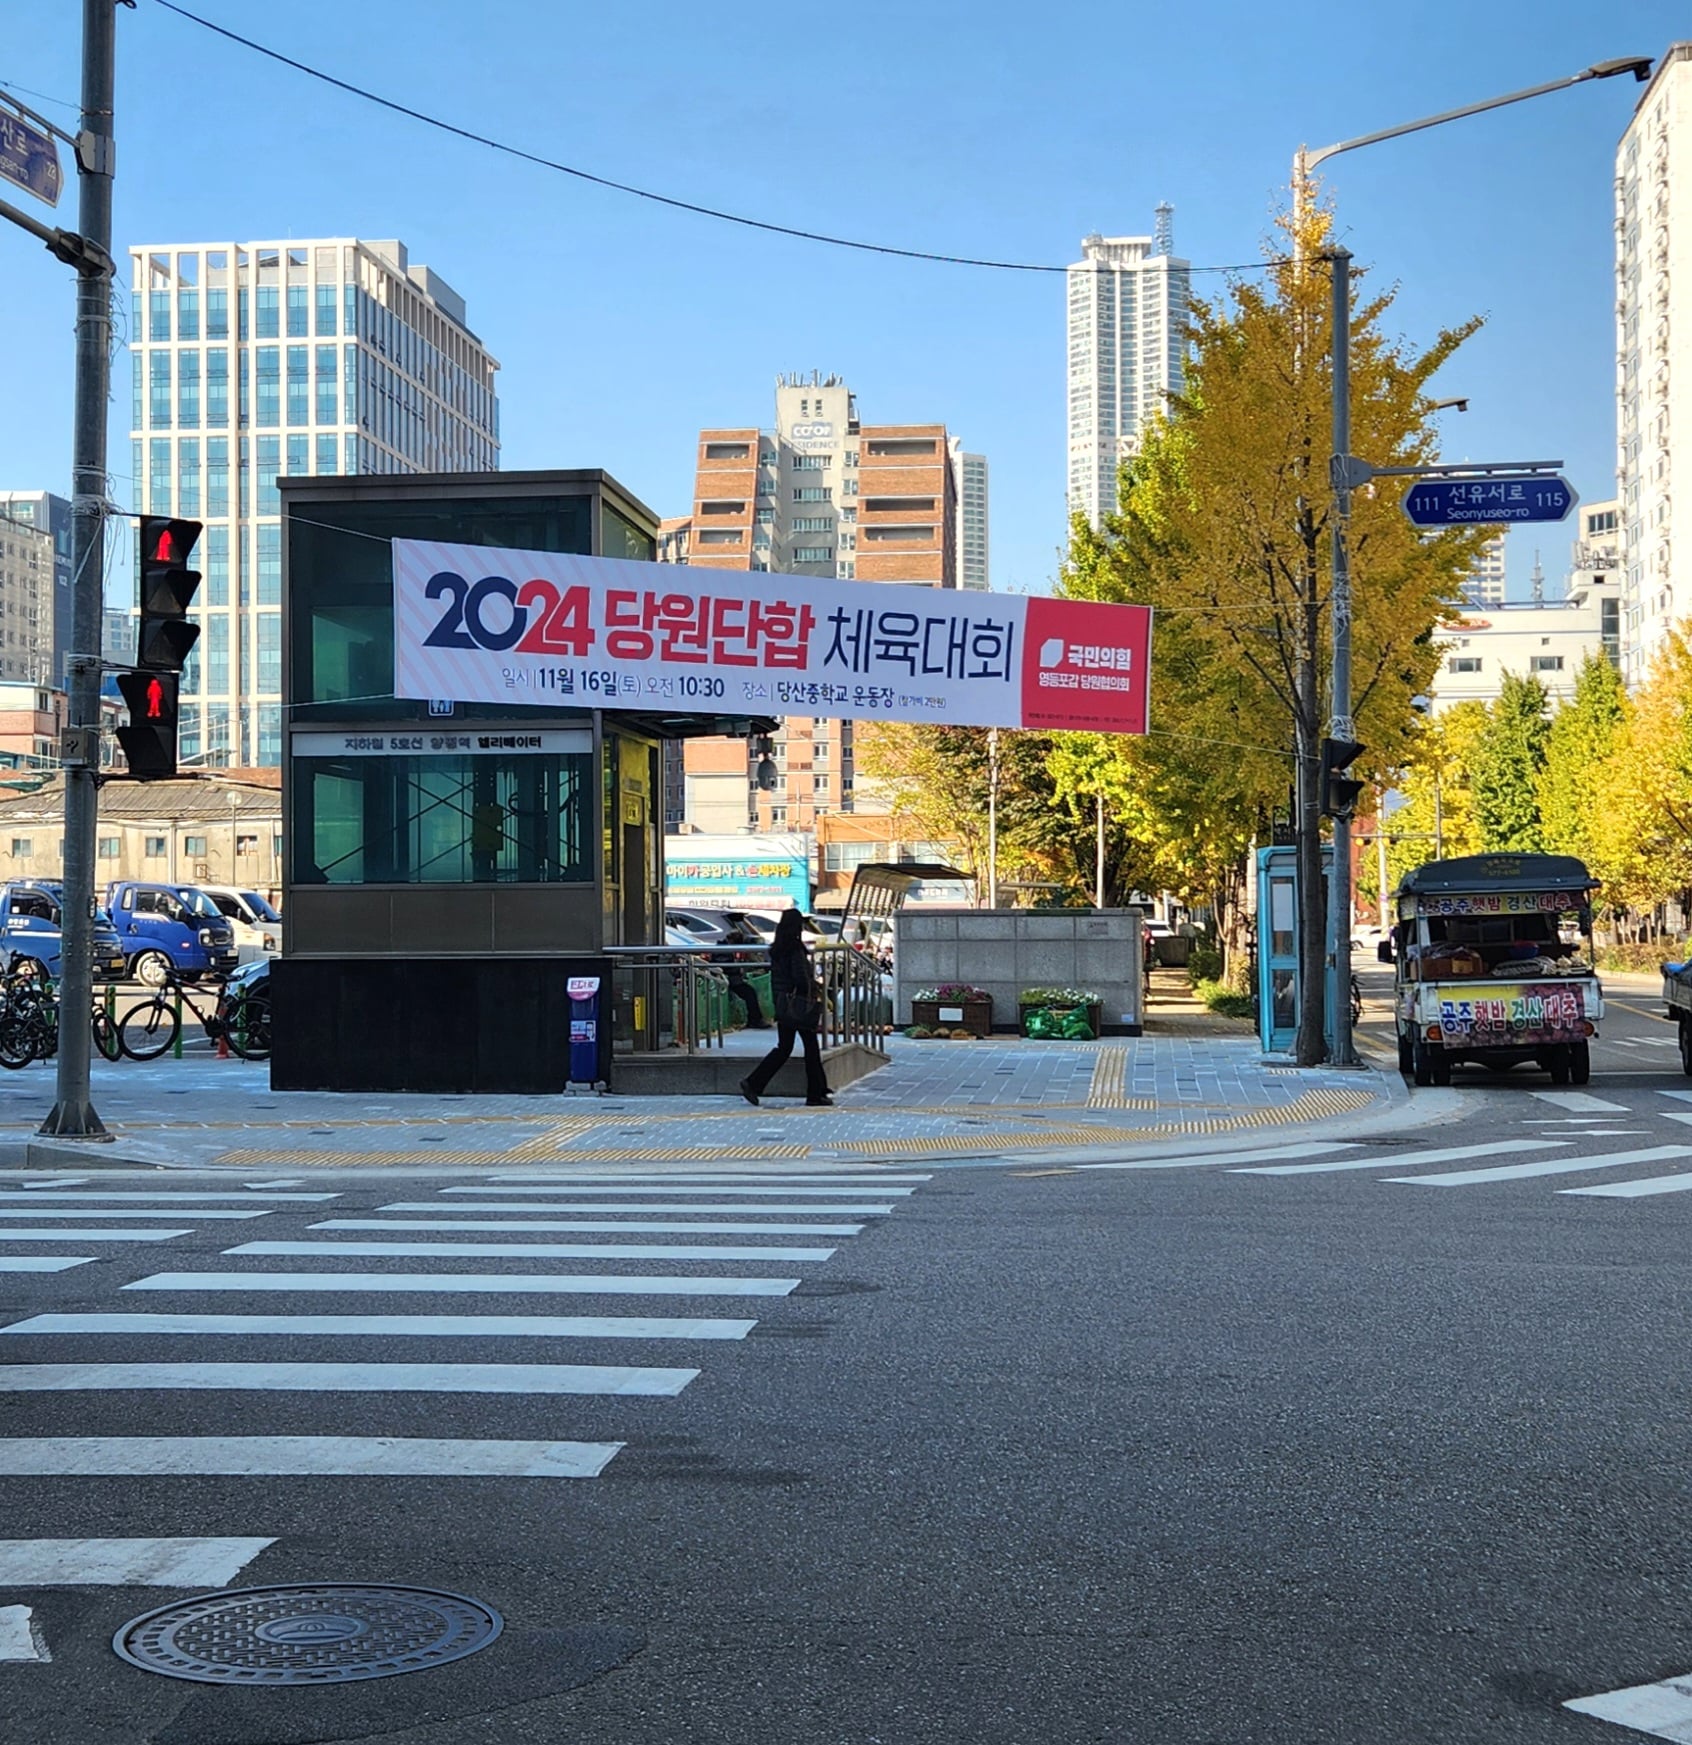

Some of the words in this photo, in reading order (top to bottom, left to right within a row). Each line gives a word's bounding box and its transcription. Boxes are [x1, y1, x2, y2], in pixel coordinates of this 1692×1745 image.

[1414, 497, 1439, 512] 111
[1449, 484, 1526, 505] 선유서로
[1536, 492, 1564, 507] 115
[1447, 506, 1529, 520] Seonyuseo-ro
[422, 571, 596, 657] 2024
[605, 589, 815, 670] 당원단합
[824, 606, 1014, 683] 체육대회
[1068, 644, 1131, 671] 국민의힘
[502, 667, 529, 689] 일시
[539, 667, 574, 695] 11월
[646, 680, 674, 698] 오전
[679, 676, 725, 698] 10:30
[742, 681, 768, 700] 장소
[777, 681, 849, 705] 당산중학교
[853, 686, 895, 709] 운동장
[1039, 671, 1078, 689] 영등포갑
[1081, 674, 1130, 692] 당원협의회
[1440, 896, 1501, 914] 공주햇밤
[1507, 894, 1571, 911] 경산대추
[1440, 1000, 1506, 1034] 공주햇밤
[1511, 992, 1578, 1030] 경산대추
